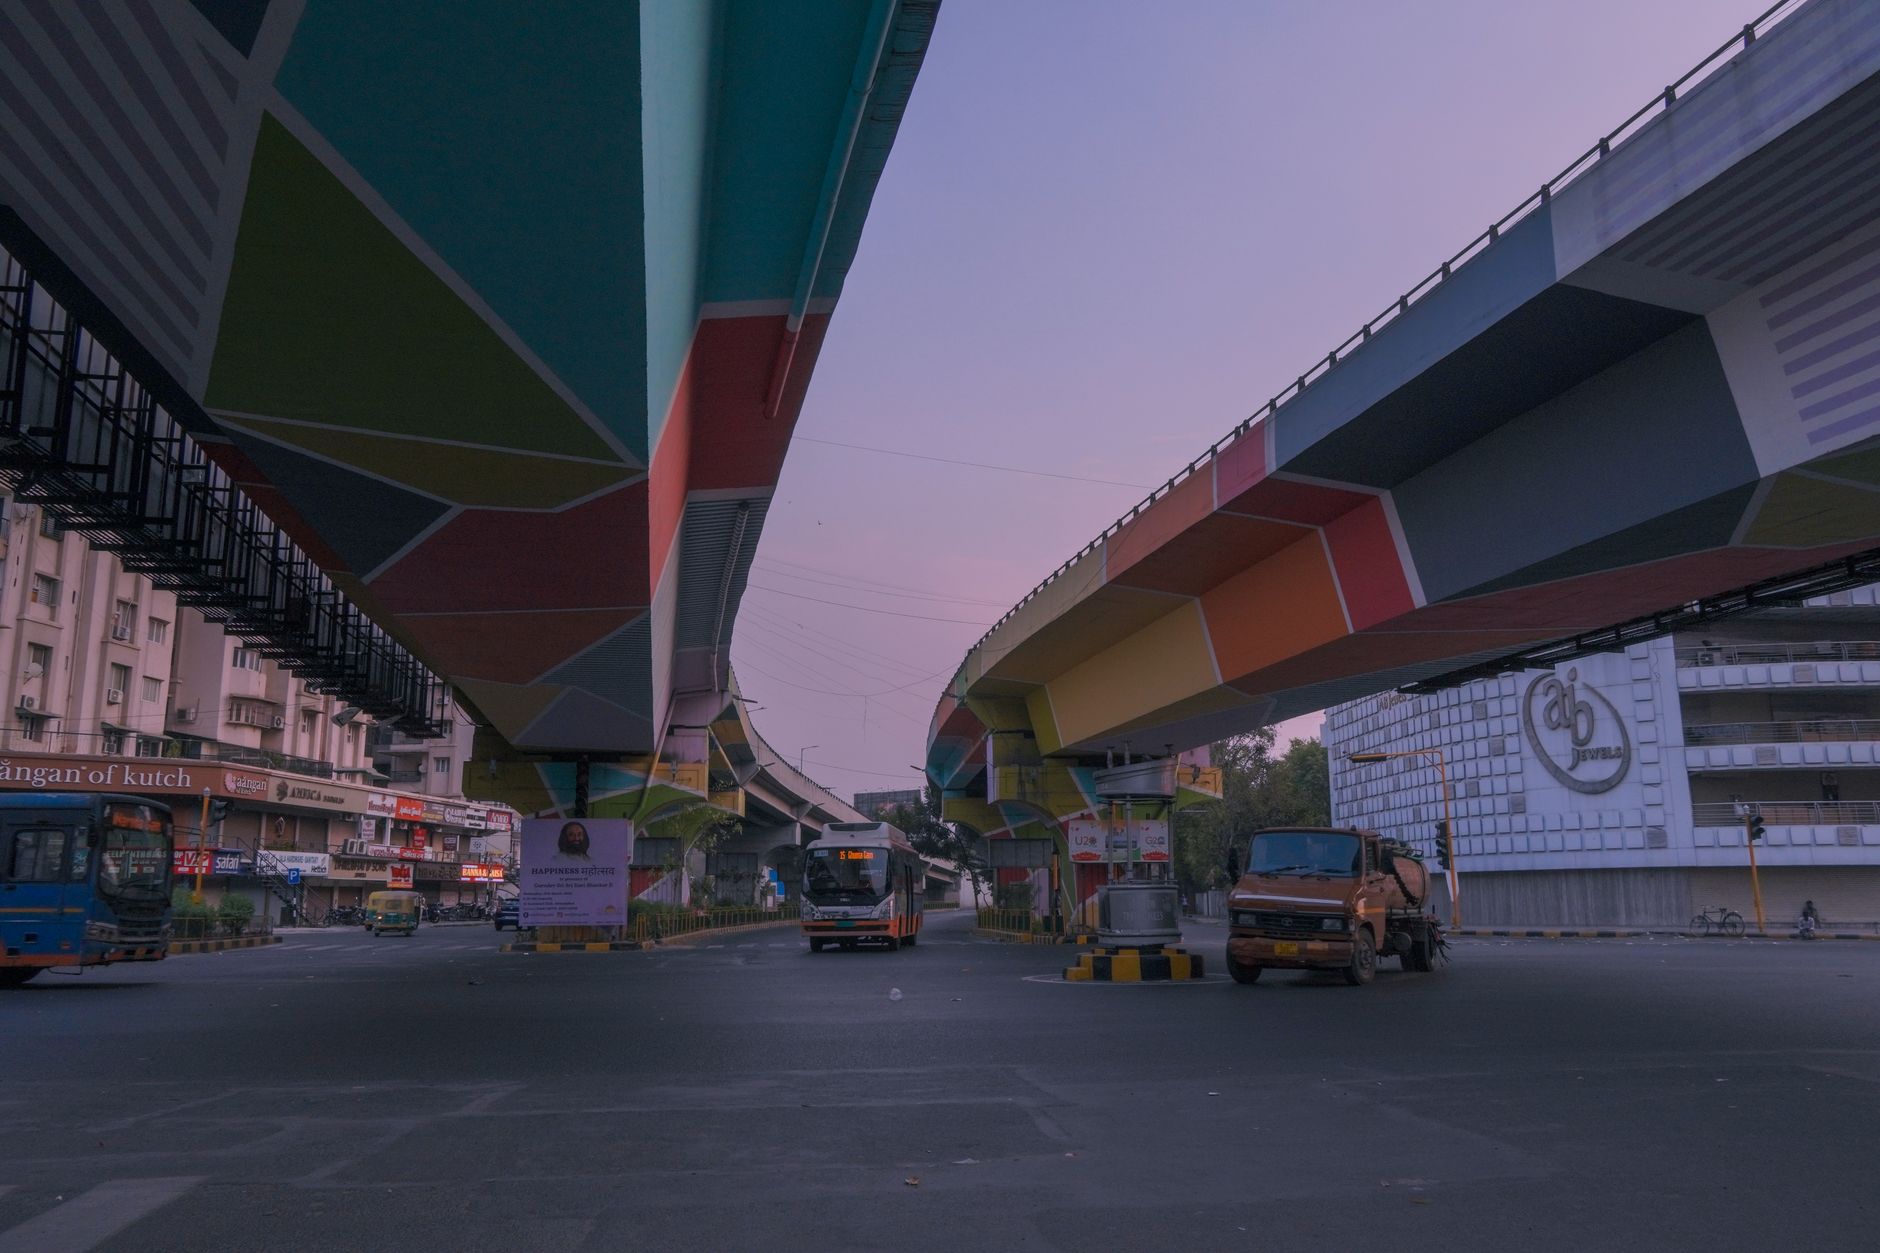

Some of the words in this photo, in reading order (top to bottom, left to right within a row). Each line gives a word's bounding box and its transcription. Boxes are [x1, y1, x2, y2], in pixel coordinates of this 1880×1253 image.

[88, 764, 118, 785] of
[122, 765, 192, 787] kutch
[215, 853, 239, 870] safari
[290, 870, 297, 880] P
[531, 867, 579, 875] HAPPINESS
